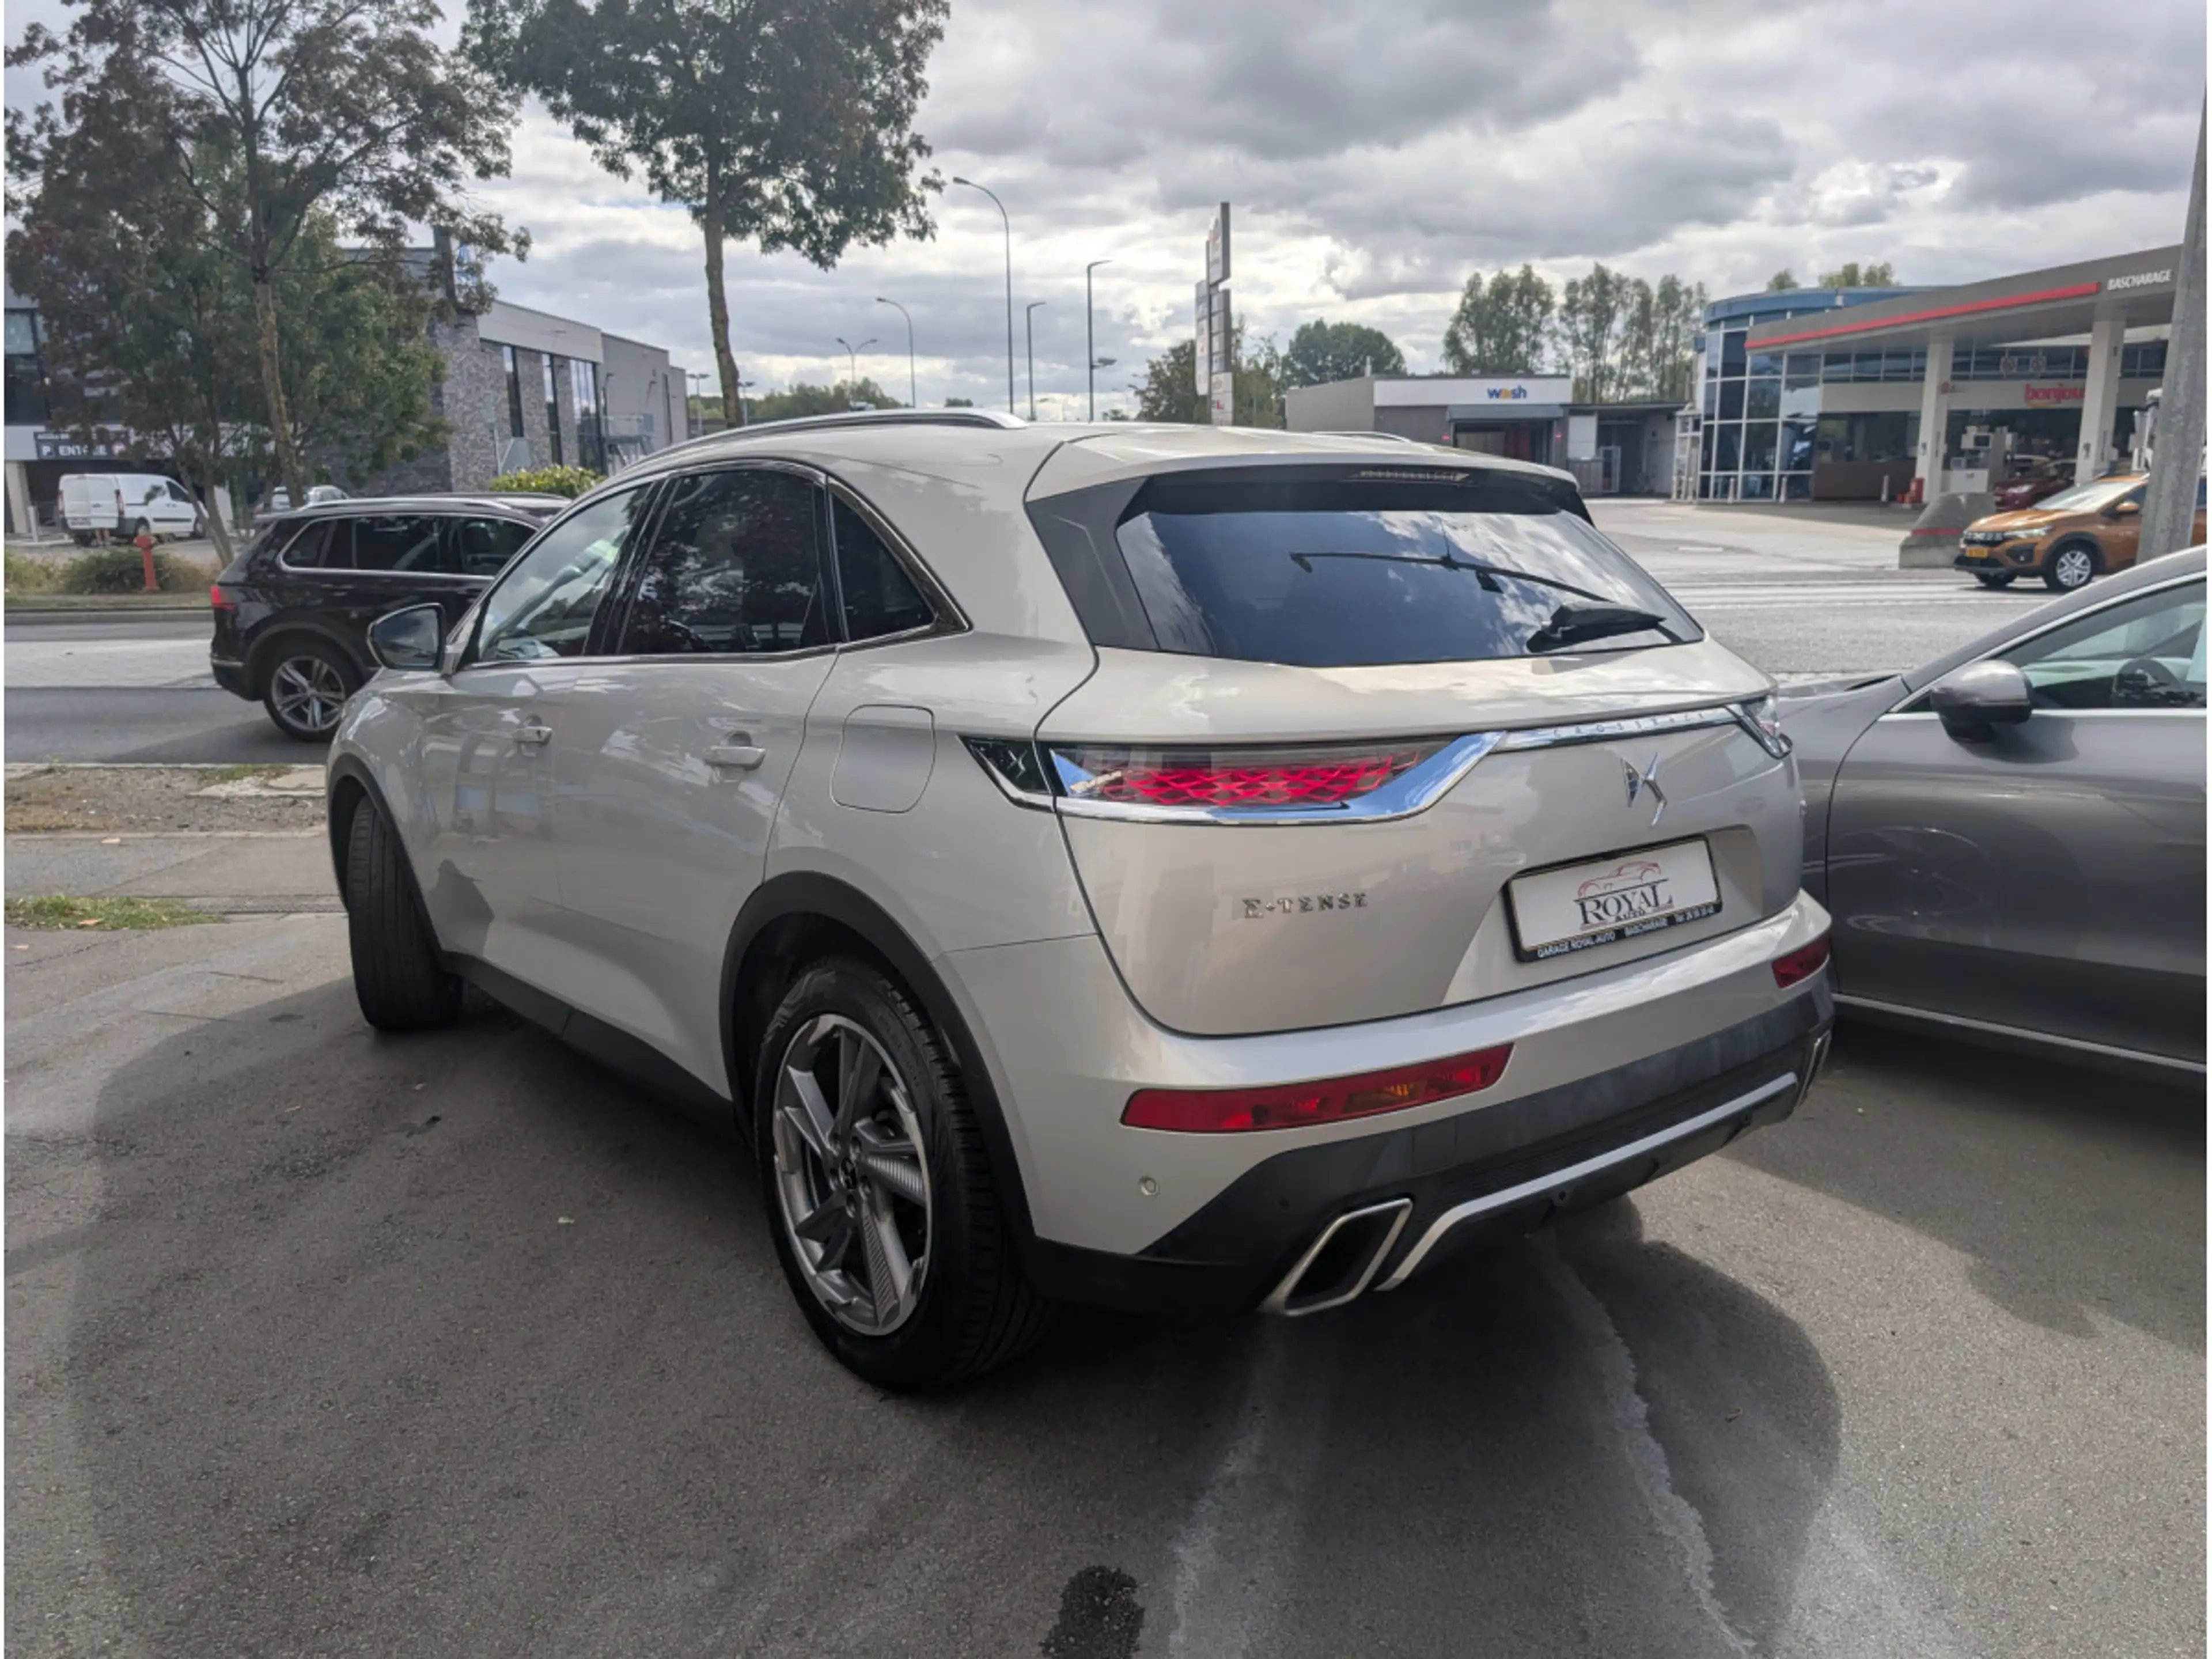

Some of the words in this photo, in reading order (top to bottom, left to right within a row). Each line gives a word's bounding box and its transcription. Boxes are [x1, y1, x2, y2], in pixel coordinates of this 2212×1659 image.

[2108, 269, 2172, 290] BASCHARAGE
[1487, 384, 1527, 399] wash
[2025, 383, 2085, 404] bonjou
[1574, 884, 1674, 924] ROYAL
[1615, 906, 1646, 922] AUTO
[1537, 942, 1569, 959] GARAGE
